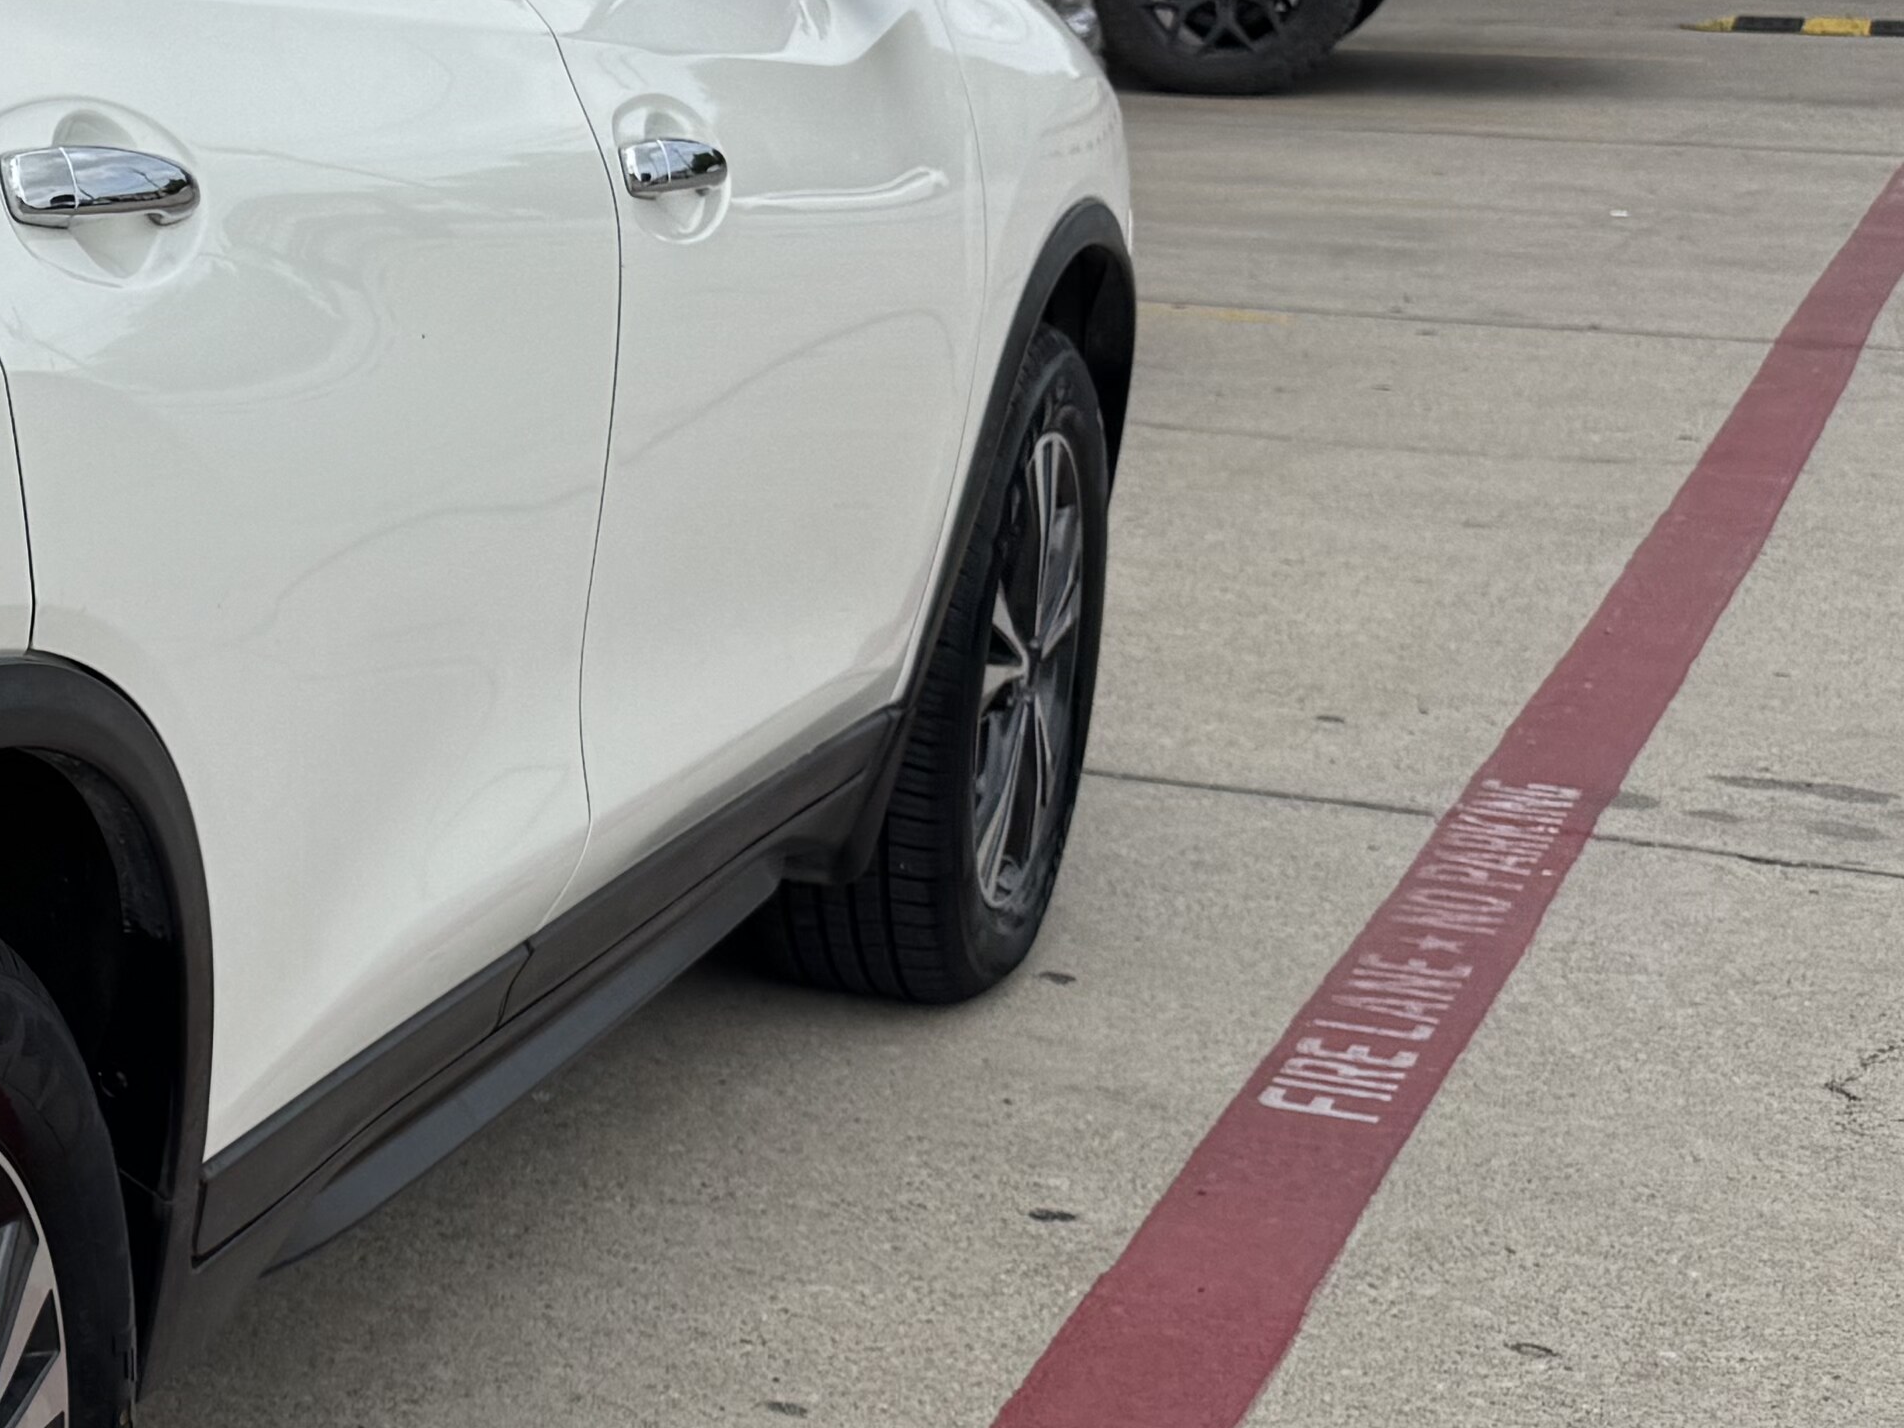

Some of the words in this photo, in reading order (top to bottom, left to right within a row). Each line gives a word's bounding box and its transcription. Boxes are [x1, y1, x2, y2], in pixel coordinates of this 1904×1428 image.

[1415, 777, 1583, 892] PARKING
[1392, 888, 1513, 935] NO
[1309, 952, 1474, 1041] LANE
[1258, 1036, 1420, 1124] FIRE
